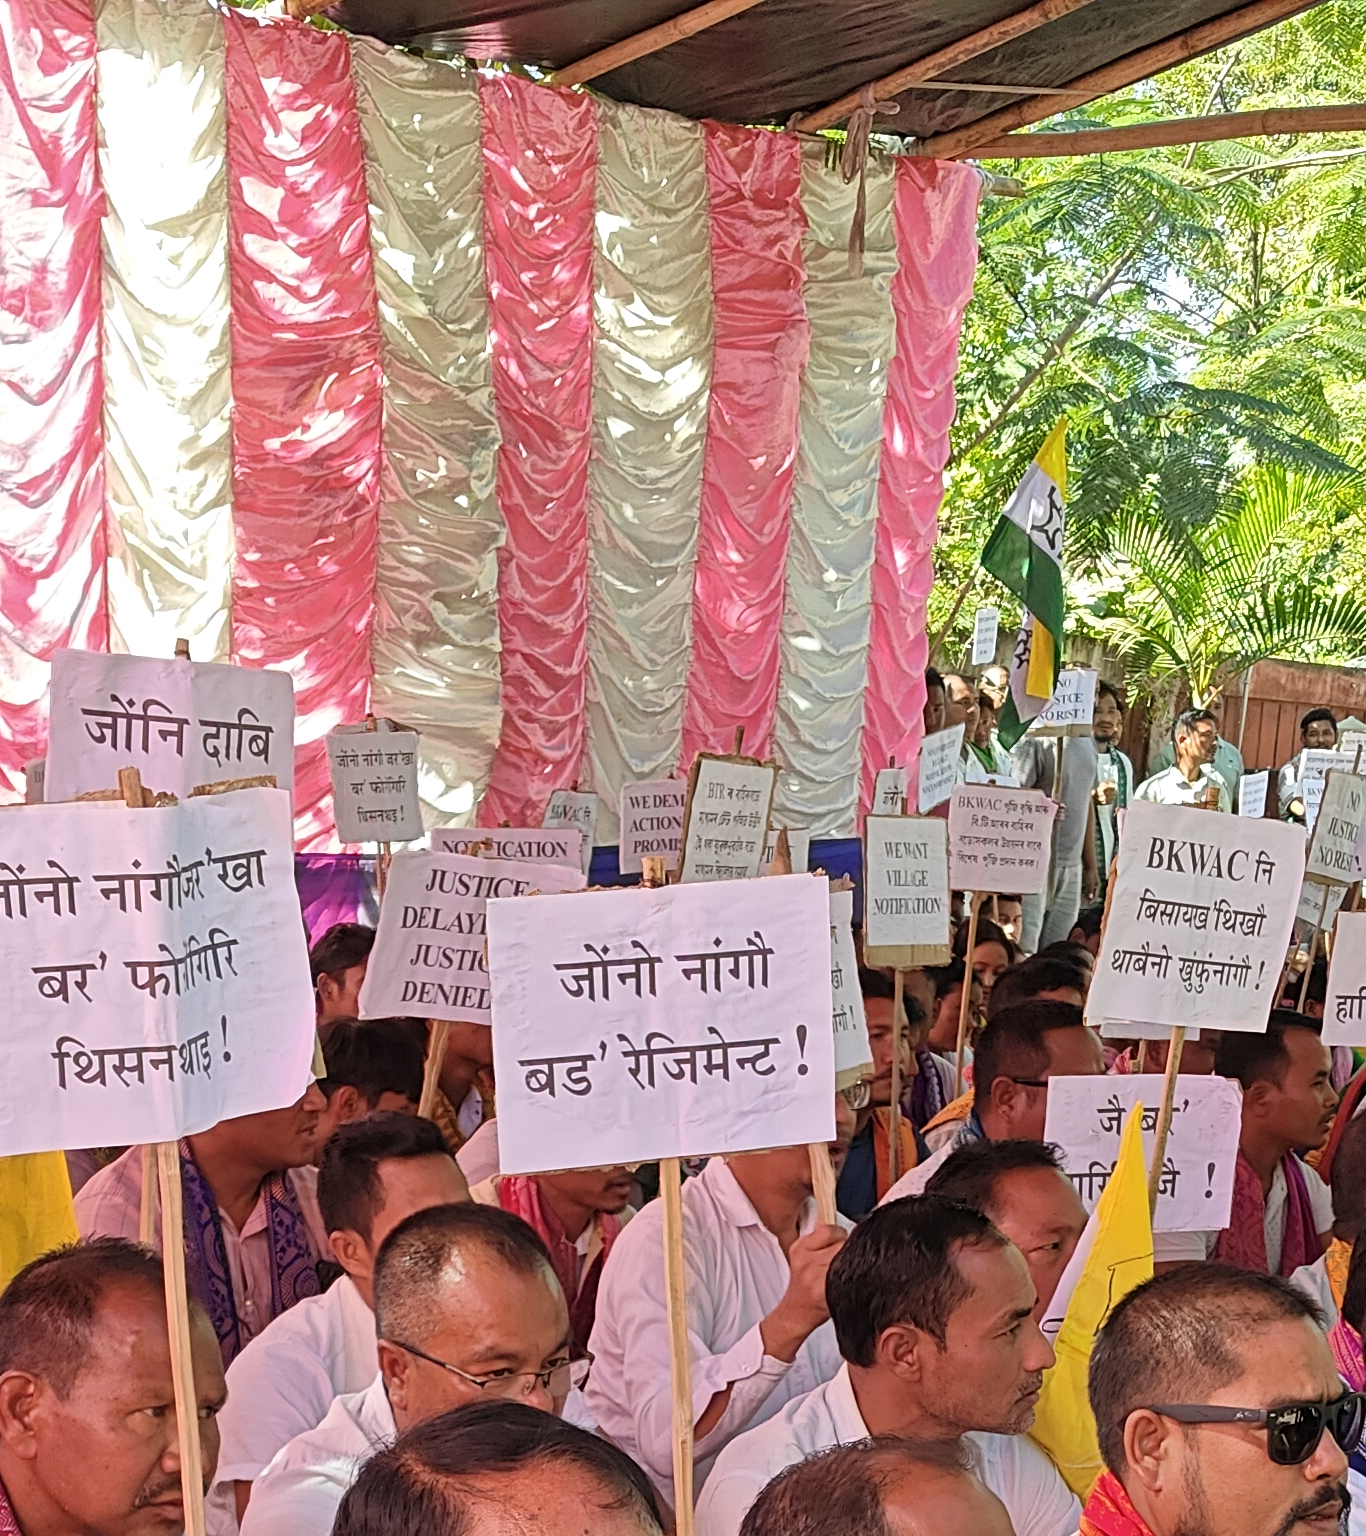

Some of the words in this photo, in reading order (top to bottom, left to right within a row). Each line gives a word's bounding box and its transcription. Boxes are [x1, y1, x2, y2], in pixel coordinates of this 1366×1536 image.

[1055, 692, 1084, 705] STICE
[80, 694, 190, 758] जोंनि
[198, 708, 274, 766] दाबि
[629, 796, 652, 809] WE
[653, 794, 685, 809] DEM
[958, 795, 1002, 810] BKWAC
[1346, 791, 1360, 813] NO
[1145, 836, 1250, 882] BKWAC
[1254, 850, 1276, 886] नि
[92, 854, 183, 913] नांगौ
[410, 944, 488, 974] JUSTIC
[553, 940, 663, 1002] जोंनो
[674, 931, 774, 994] नांगौ
[1111, 941, 1173, 980] थाबैनो
[616, 1026, 782, 1091] रेजिमेन्ट
[1096, 1094, 1127, 1136] जै
